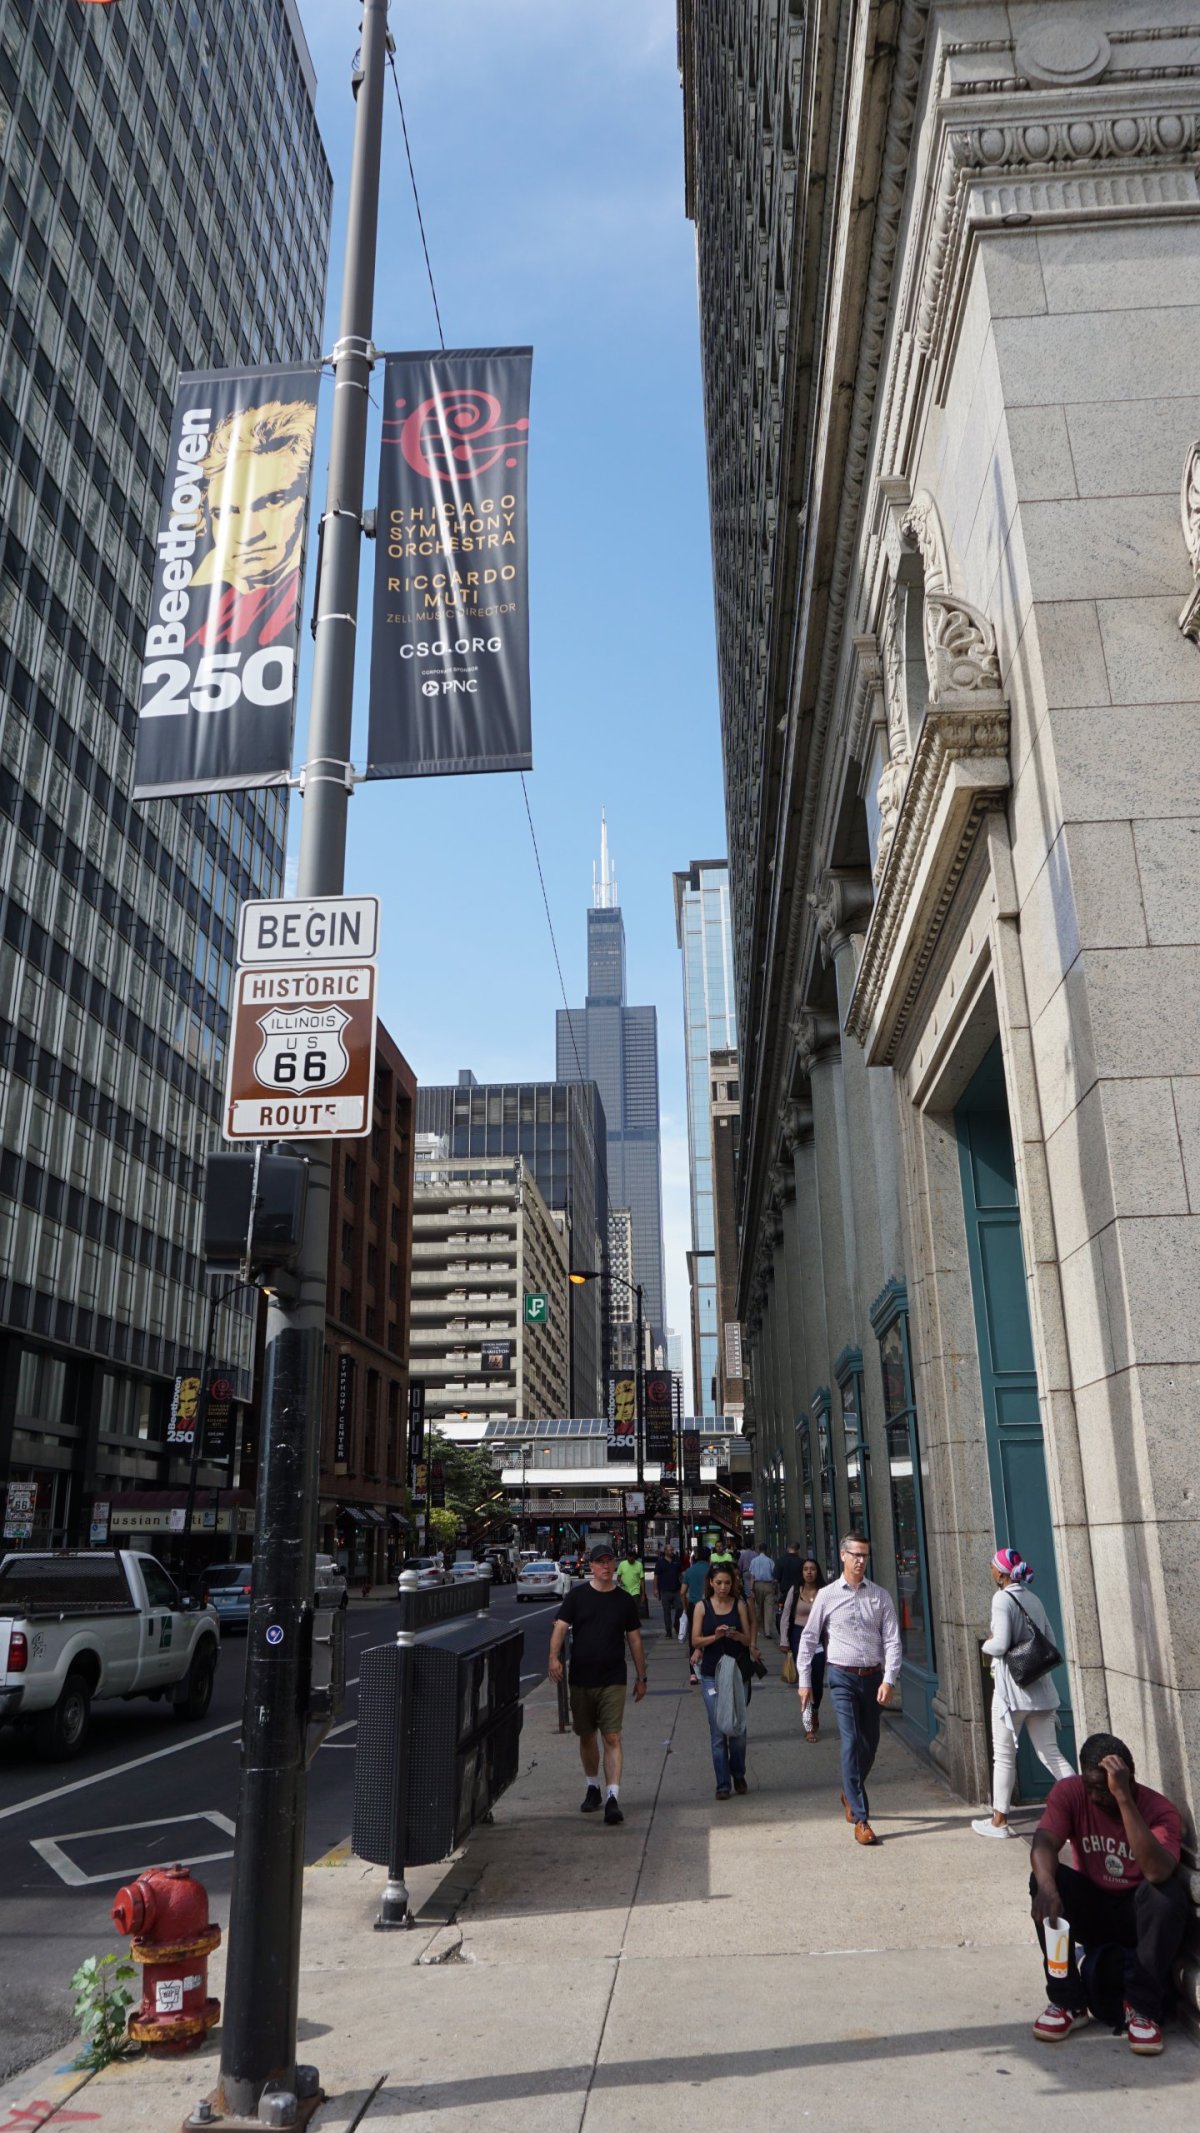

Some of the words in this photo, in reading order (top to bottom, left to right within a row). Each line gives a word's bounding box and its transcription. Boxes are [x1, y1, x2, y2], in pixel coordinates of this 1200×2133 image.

[390, 494, 515, 523] CHICAGO
[146, 408, 211, 657] Beethoven
[390, 512, 515, 540] SYMPHONY
[388, 530, 516, 558] ORCHESTRA
[388, 565, 516, 592] RICCARDO
[424, 589, 478, 607] MUTI
[386, 613, 413, 624] ZELL
[415, 610, 455, 622] MUSIC
[457, 602, 517, 619] DIRECTOR
[399, 636, 502, 659] CSO.ORG
[139, 645, 295, 719] 250
[421, 668, 452, 676] CORPORATE
[453, 665, 479, 673] SPONSOR
[442, 679, 478, 695] PNC
[257, 911, 361, 950] BEGIN
[252, 974, 360, 999] HISTORIC
[270, 1014, 337, 1030] ILLINOIS
[273, 1050, 327, 1083] 66
[339, 1358, 347, 1411] SYMPHONY
[167, 1376, 182, 1430] Beethoven
[607, 1379, 615, 1434] Beethoven
[411, 1388, 421, 1455] OPU
[166, 1430, 195, 1443] 250
[337, 1416, 345, 1457] CENTER
[607, 1435, 635, 1447] 250
[660, 1471, 677, 1479] 250
[15, 1500, 28, 1510] 66
[411, 1493, 427, 1501] 250
[112, 1514, 160, 1525] ussian
[192, 1513, 224, 1525] tie
